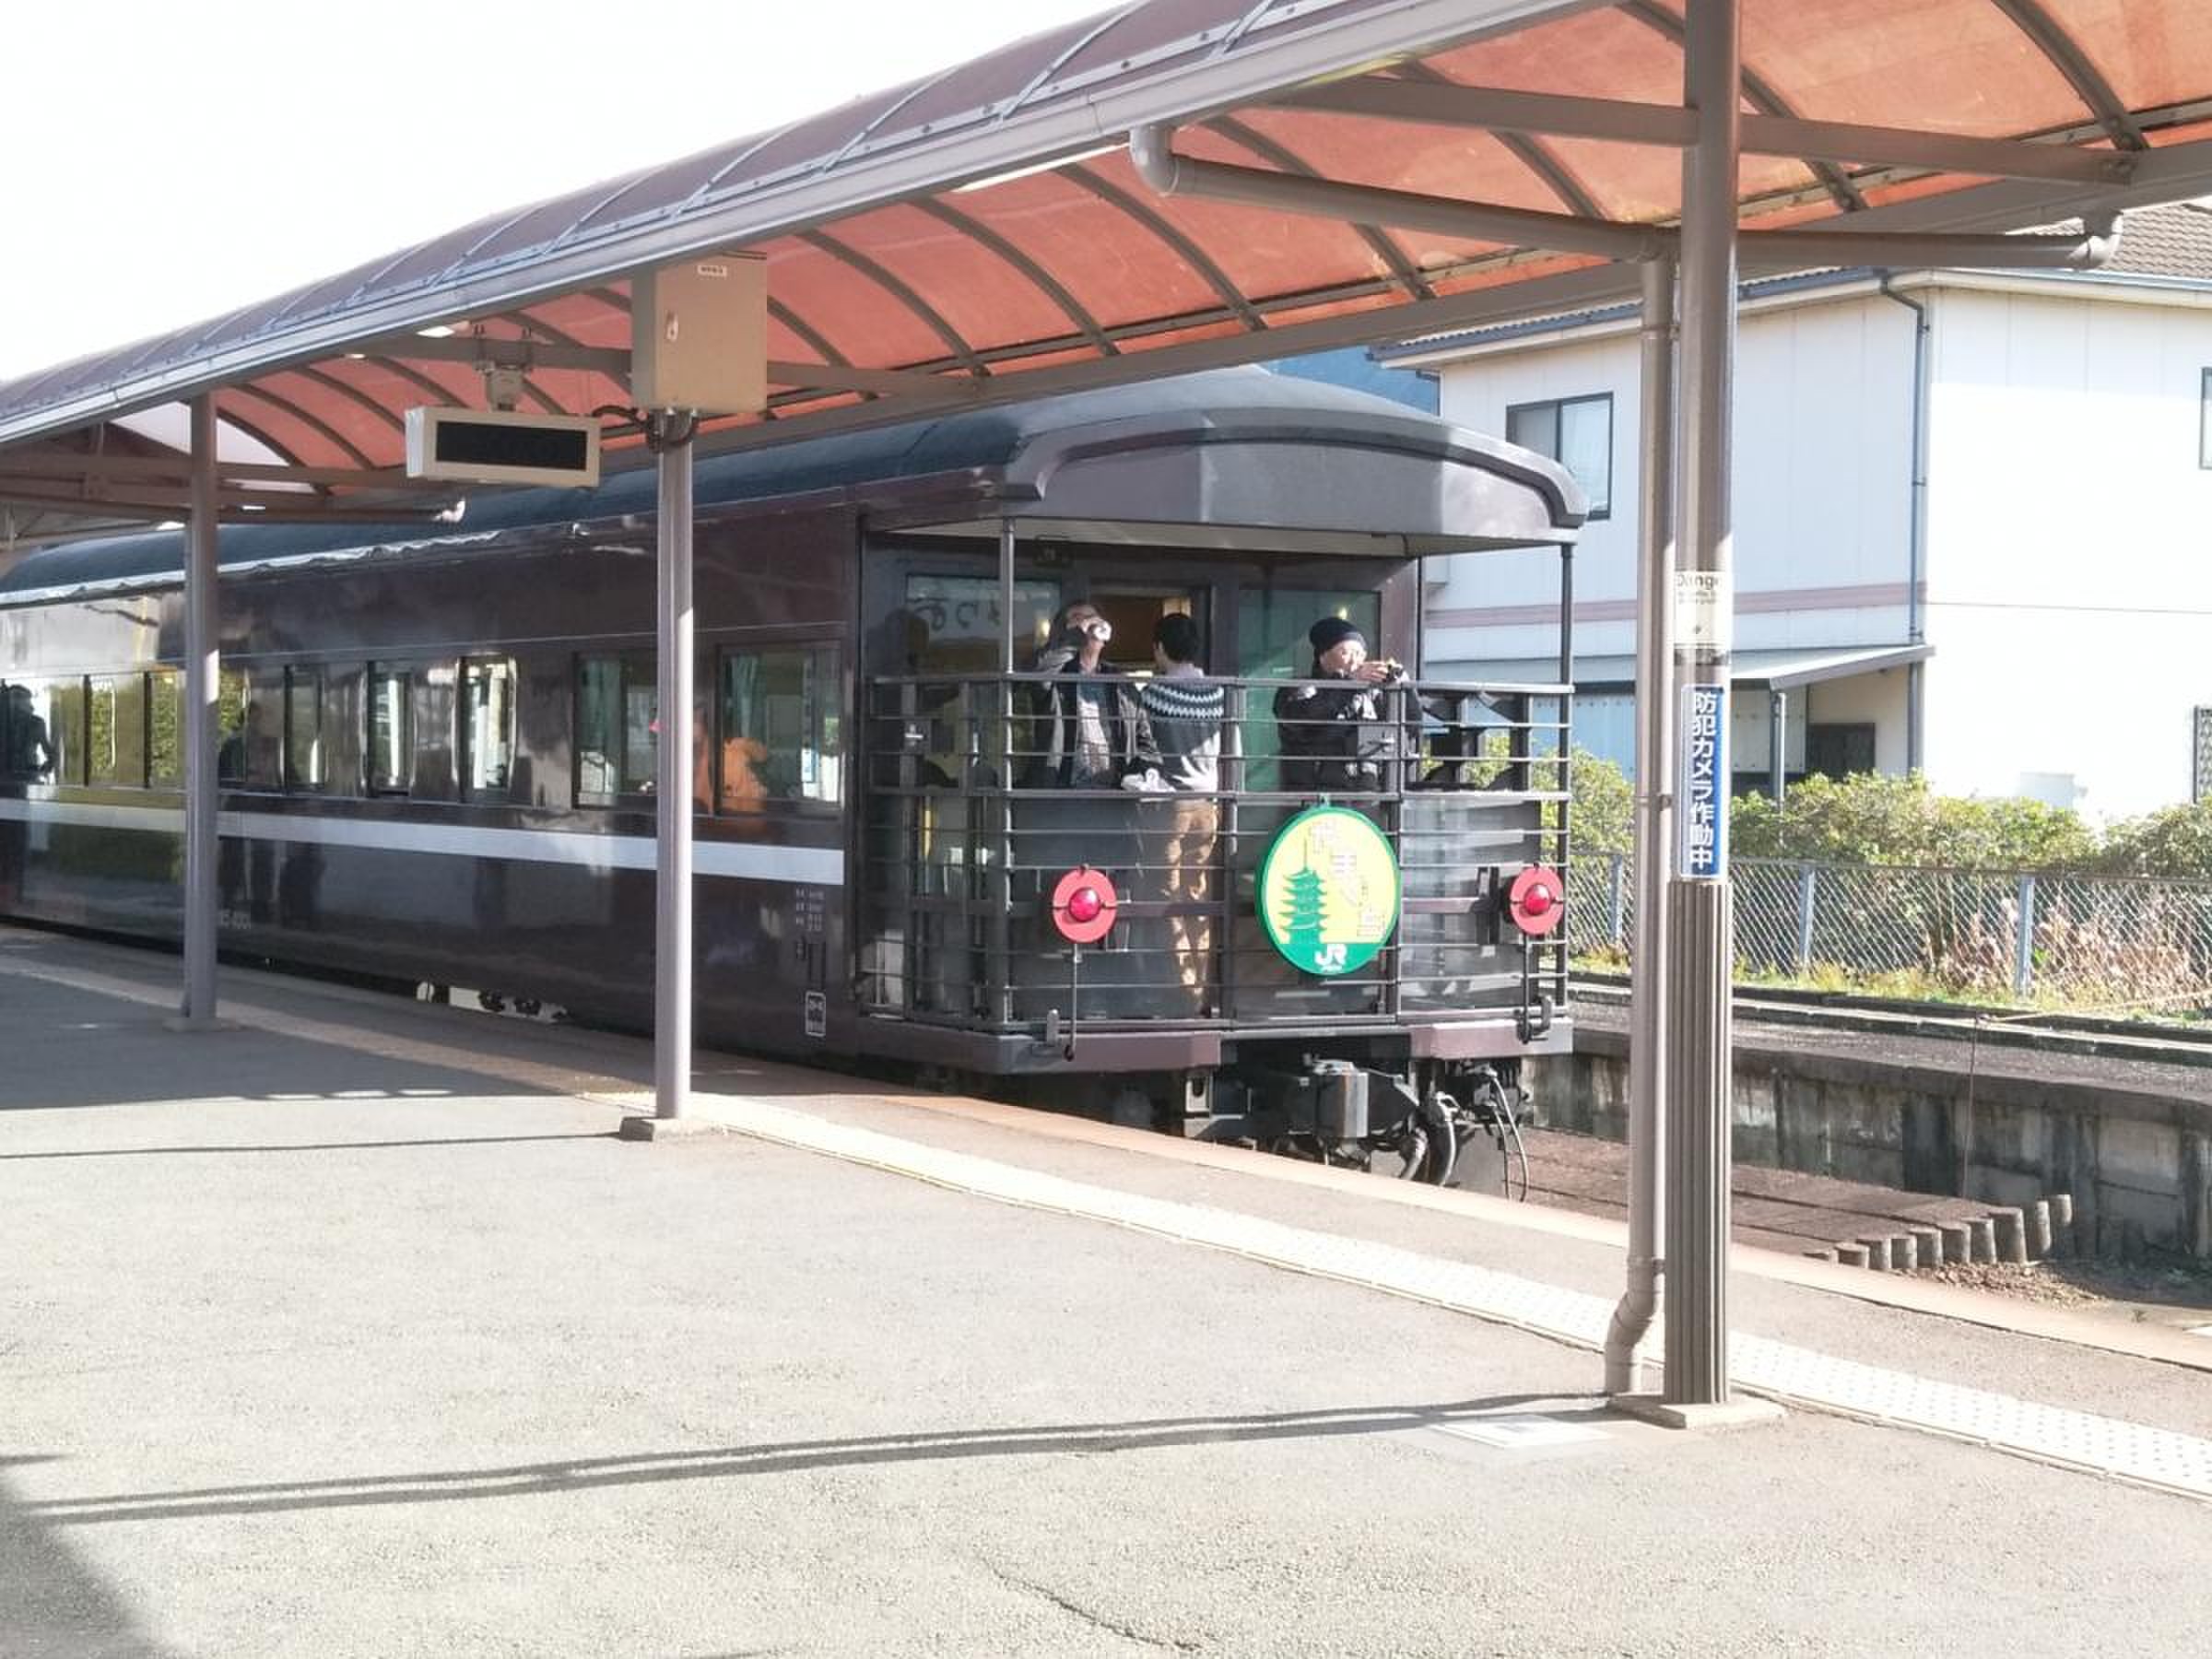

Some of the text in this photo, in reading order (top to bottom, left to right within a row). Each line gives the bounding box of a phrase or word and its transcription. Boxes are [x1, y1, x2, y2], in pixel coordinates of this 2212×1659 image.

[1690, 692, 1717, 870] 防犯カメラ作動中
[1314, 944, 1346, 966] JR
